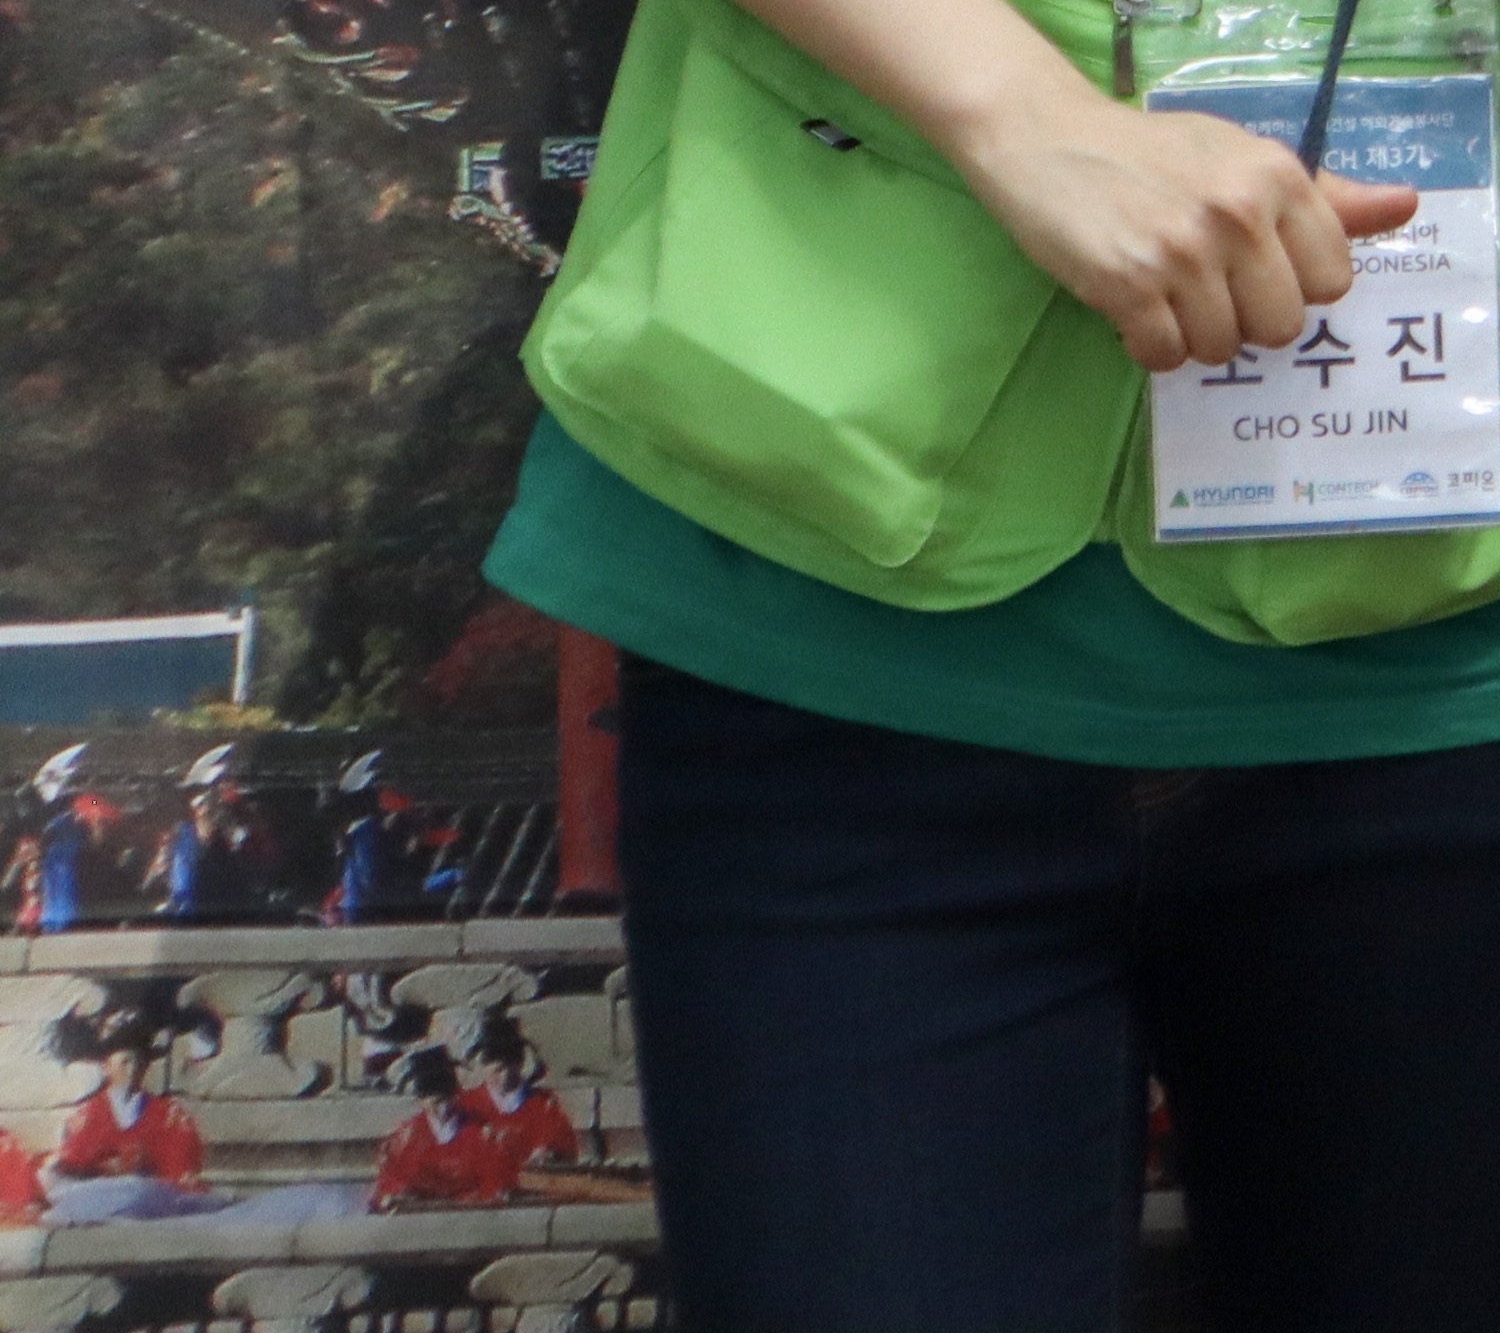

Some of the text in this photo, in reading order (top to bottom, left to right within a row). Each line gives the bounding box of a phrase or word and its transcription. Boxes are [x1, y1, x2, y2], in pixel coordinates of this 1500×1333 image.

[1233, 408, 1408, 441] CHO SU JIN
[1193, 485, 1275, 502] HYUNDAI
[1446, 469, 1495, 492] 코피온
